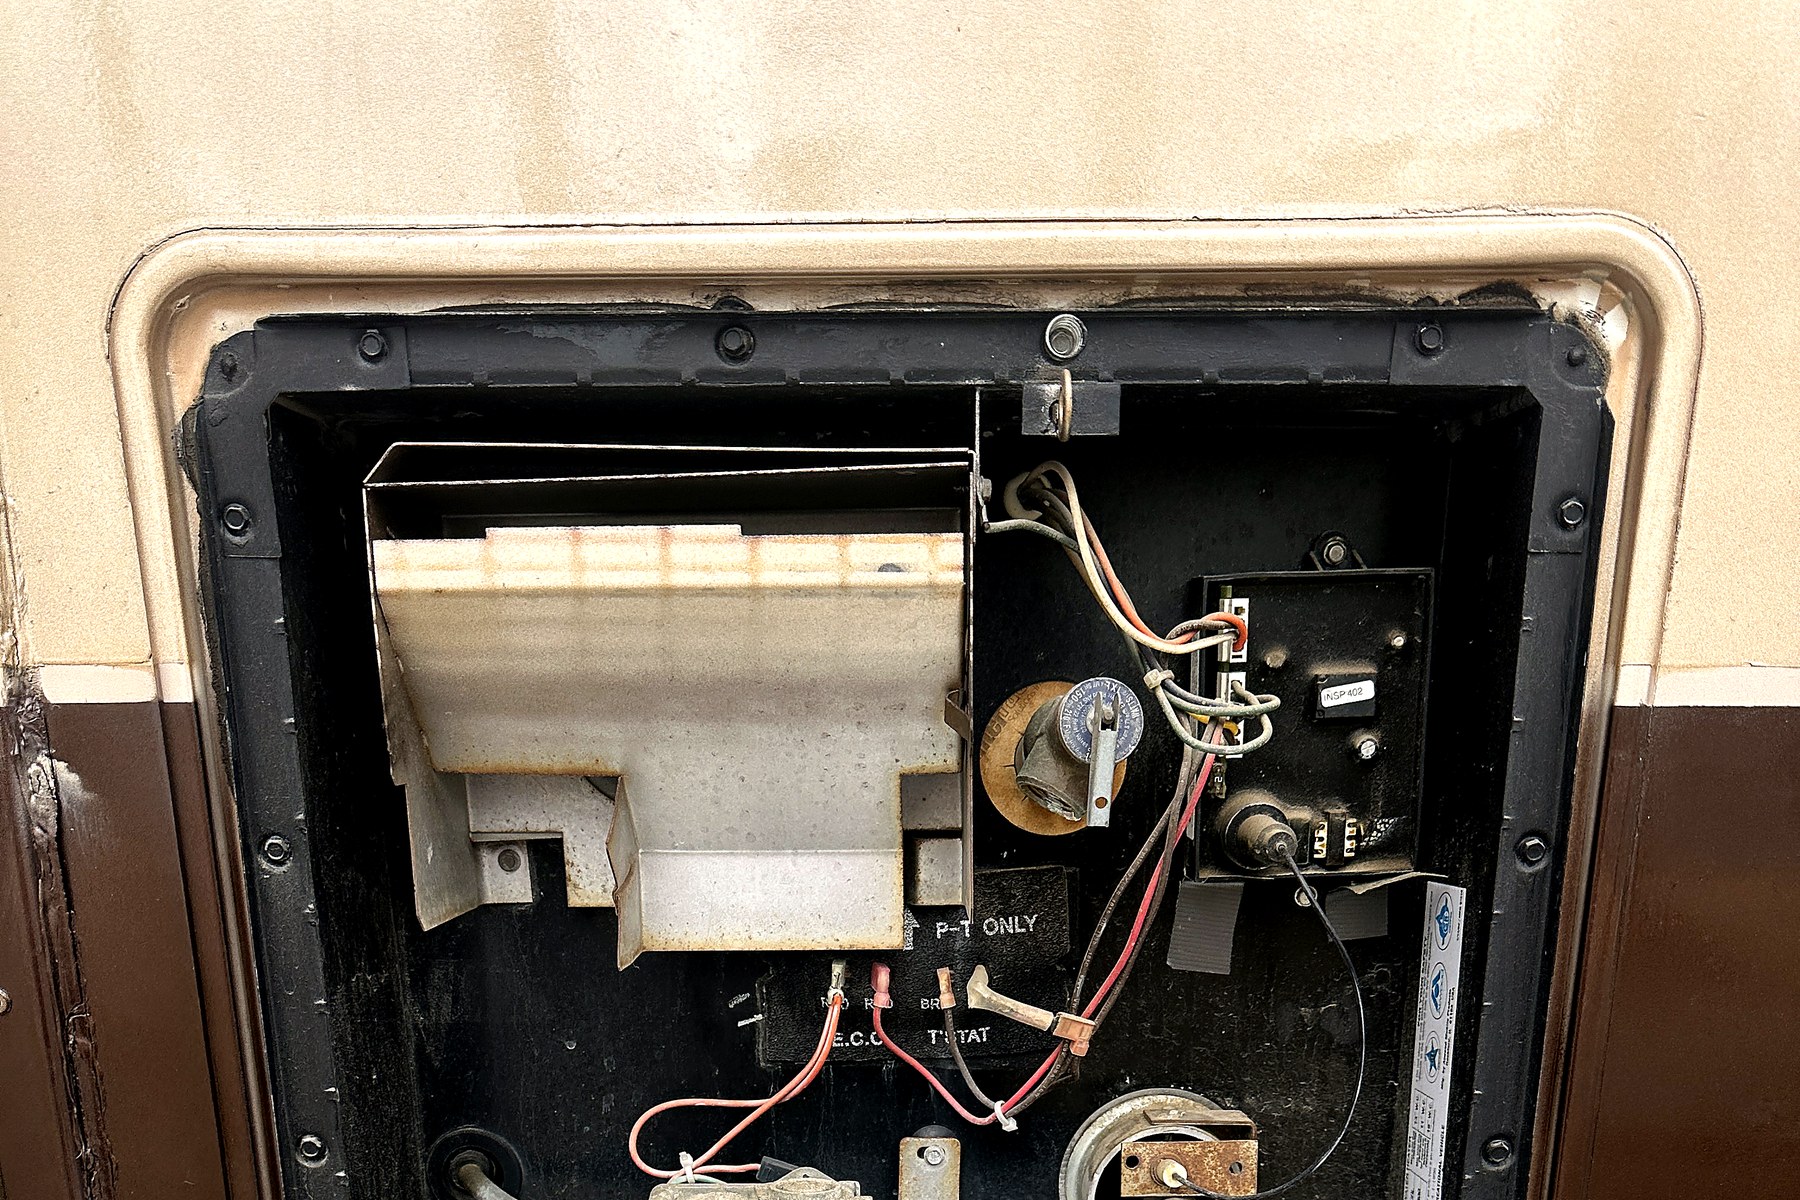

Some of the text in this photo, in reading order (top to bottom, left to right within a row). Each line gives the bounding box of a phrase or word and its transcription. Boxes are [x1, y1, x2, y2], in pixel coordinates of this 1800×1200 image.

[1323, 687, 1364, 702] INSP 402
[983, 915, 1038, 936] ONLY
